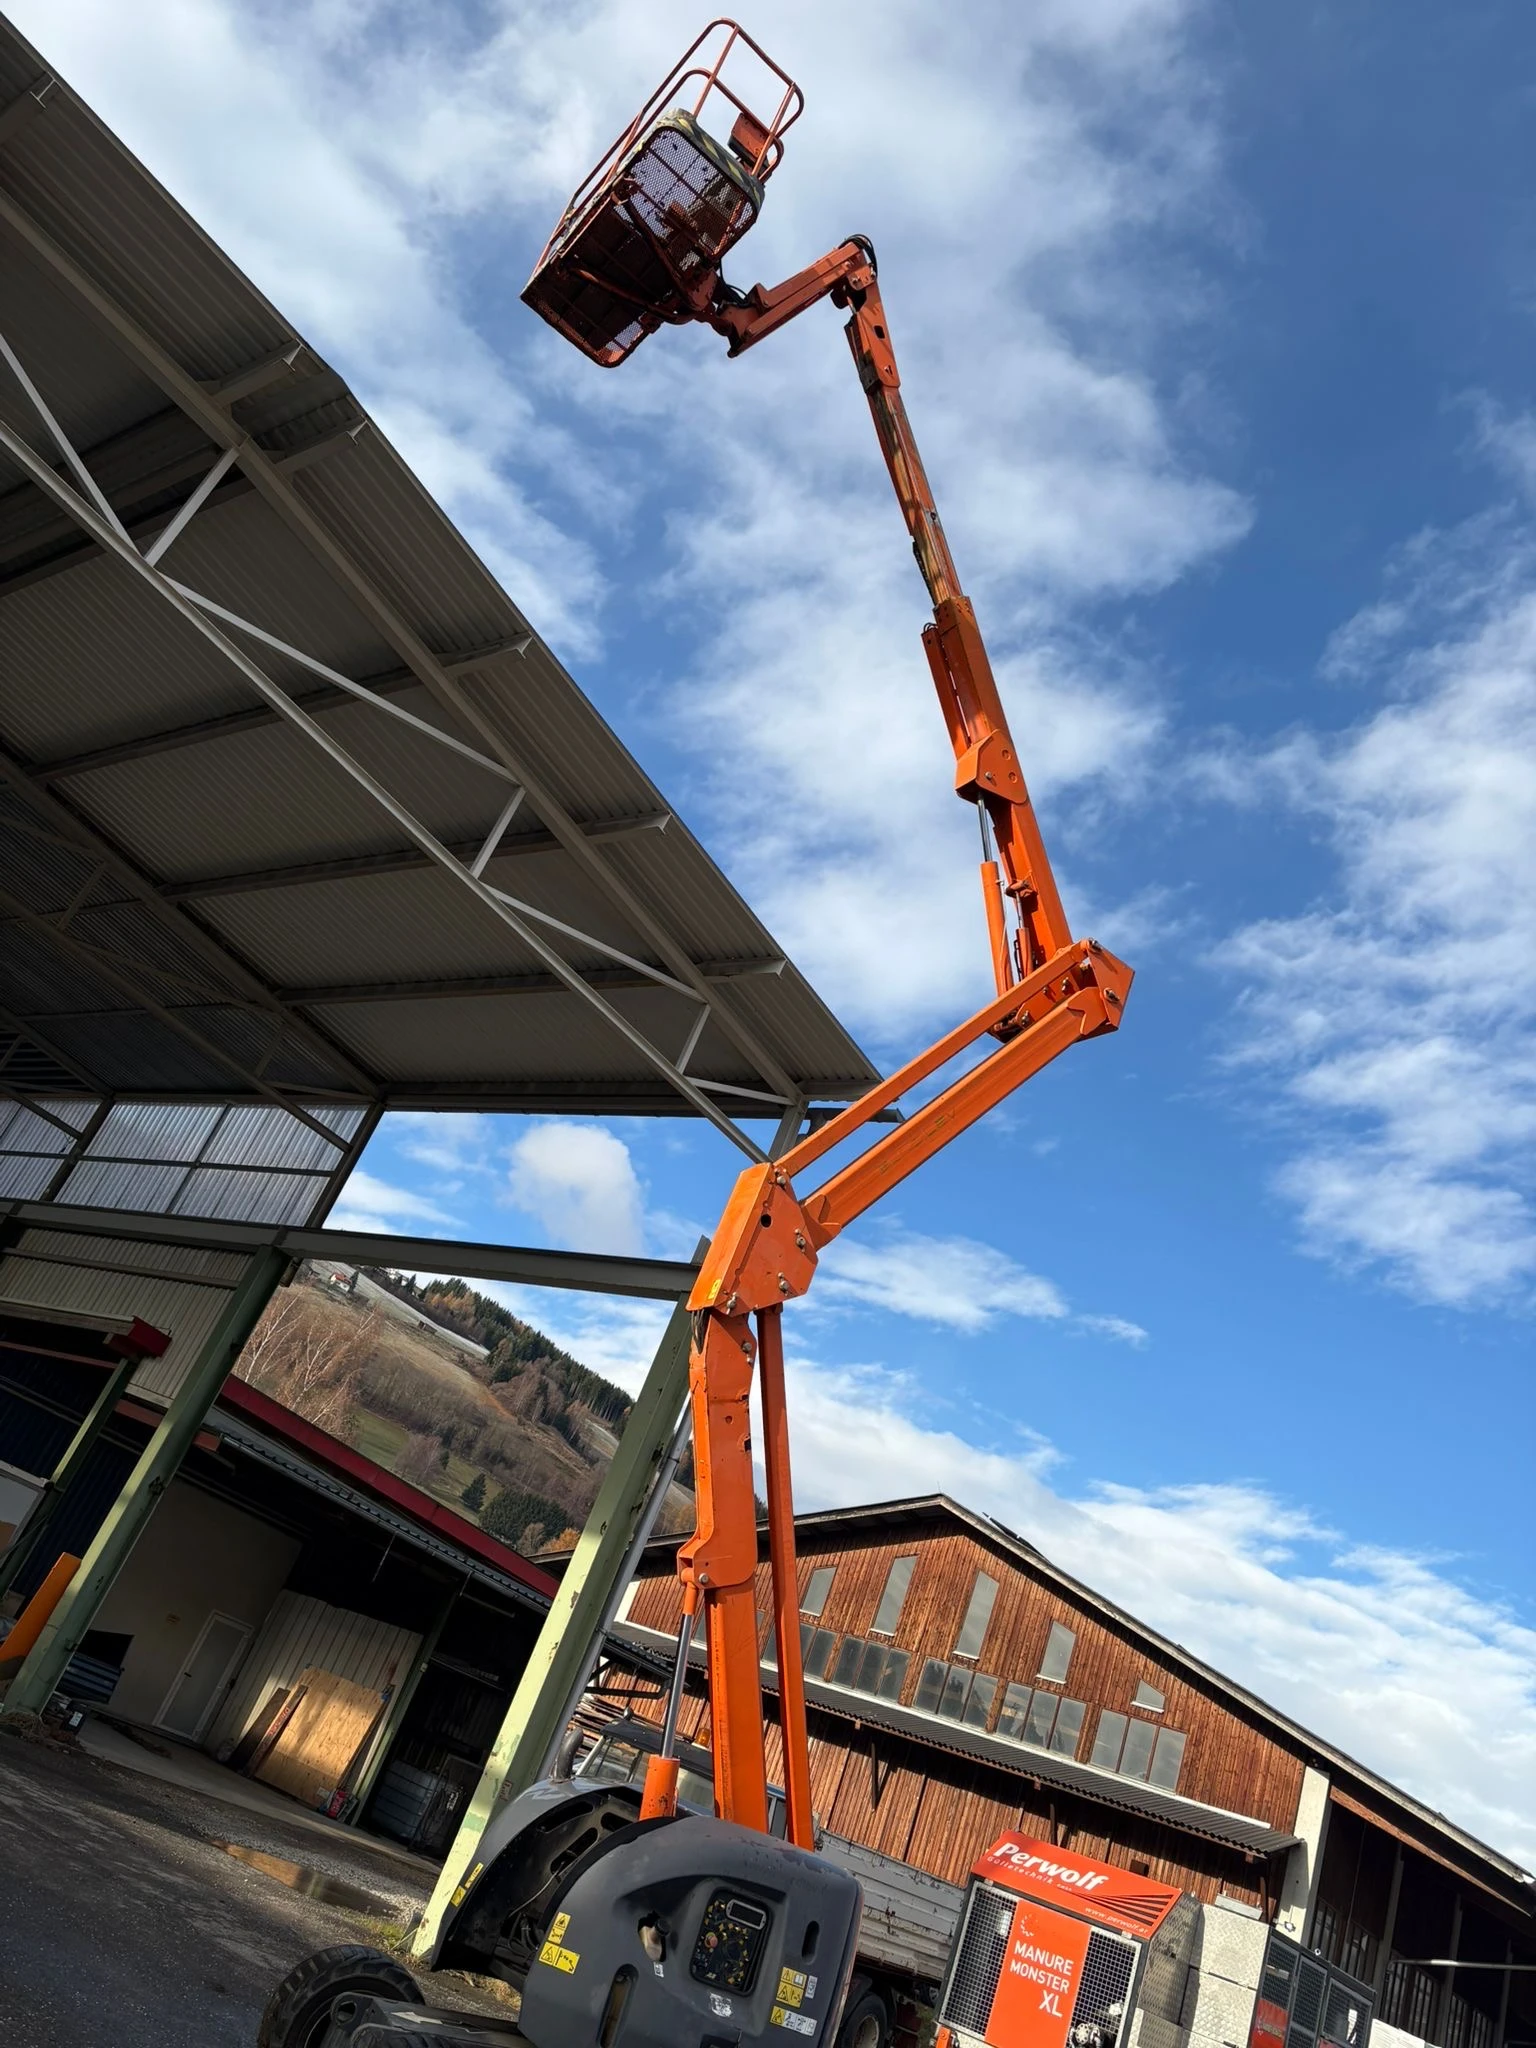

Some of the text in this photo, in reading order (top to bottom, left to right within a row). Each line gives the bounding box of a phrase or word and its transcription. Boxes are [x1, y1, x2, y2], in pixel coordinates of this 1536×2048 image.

[994, 1842, 1109, 1891] Perwolf
[1014, 1940, 1074, 1976] MANURE
[1010, 1959, 1070, 1994] MONSTER
[1039, 1990, 1063, 2018] XL
